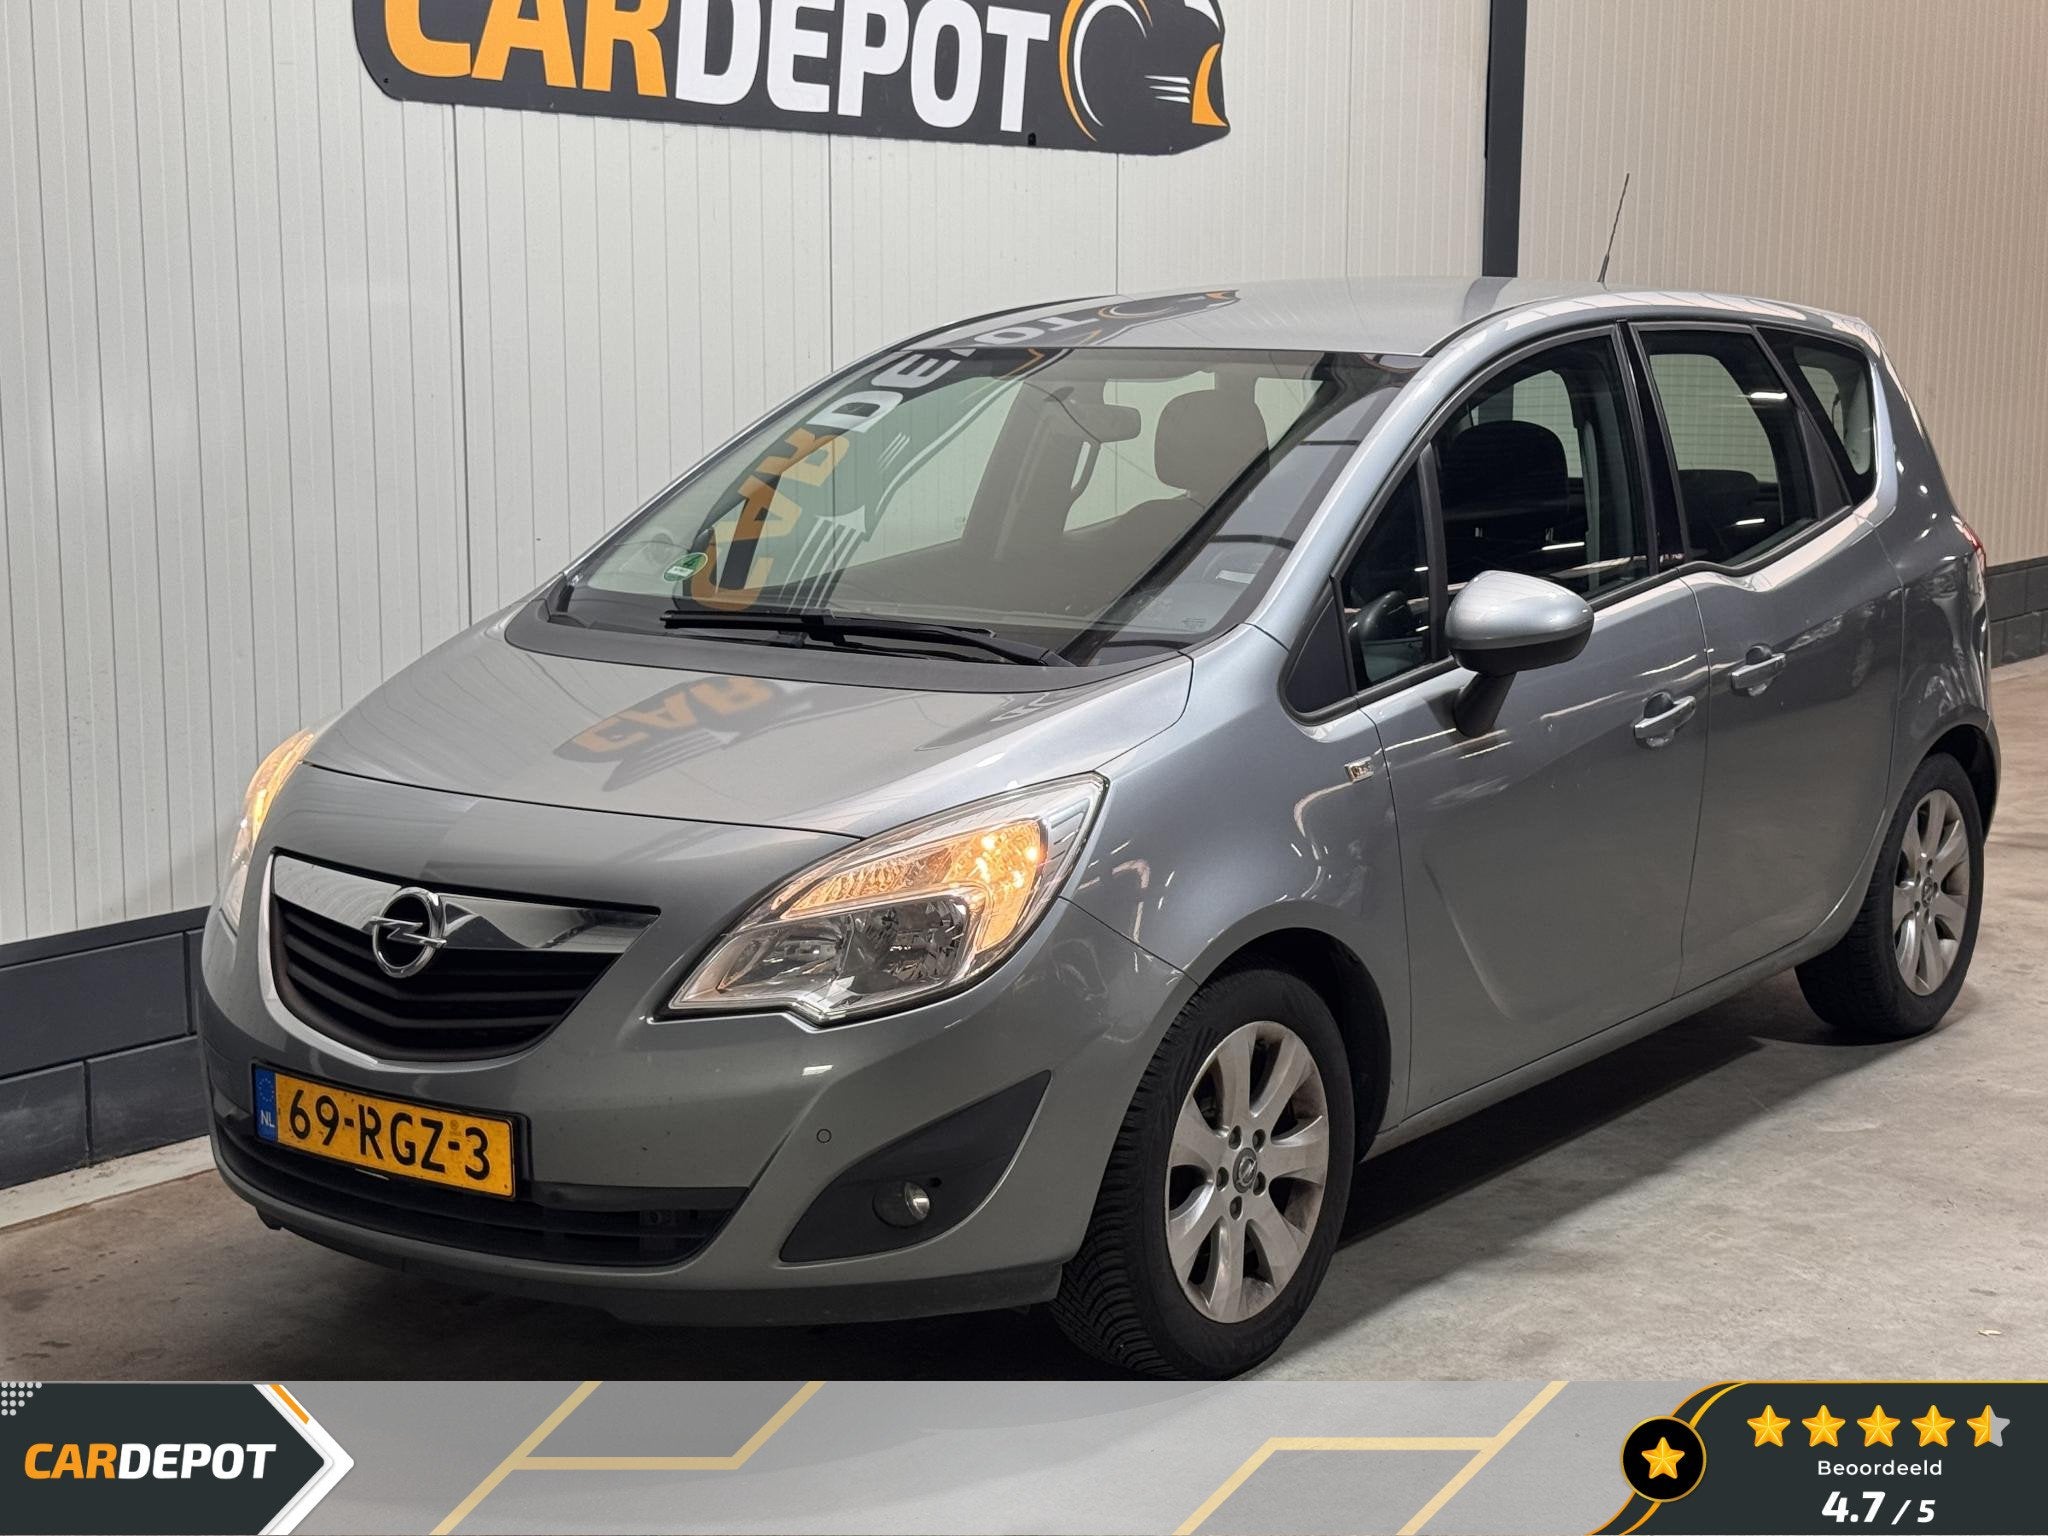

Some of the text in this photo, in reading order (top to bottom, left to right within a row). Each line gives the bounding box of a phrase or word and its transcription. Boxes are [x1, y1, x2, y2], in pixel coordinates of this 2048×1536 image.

[384, 0, 1050, 133] CARDEPOT
[260, 1109, 275, 1129] NL
[289, 1089, 491, 1181] 69-RGZ-3
